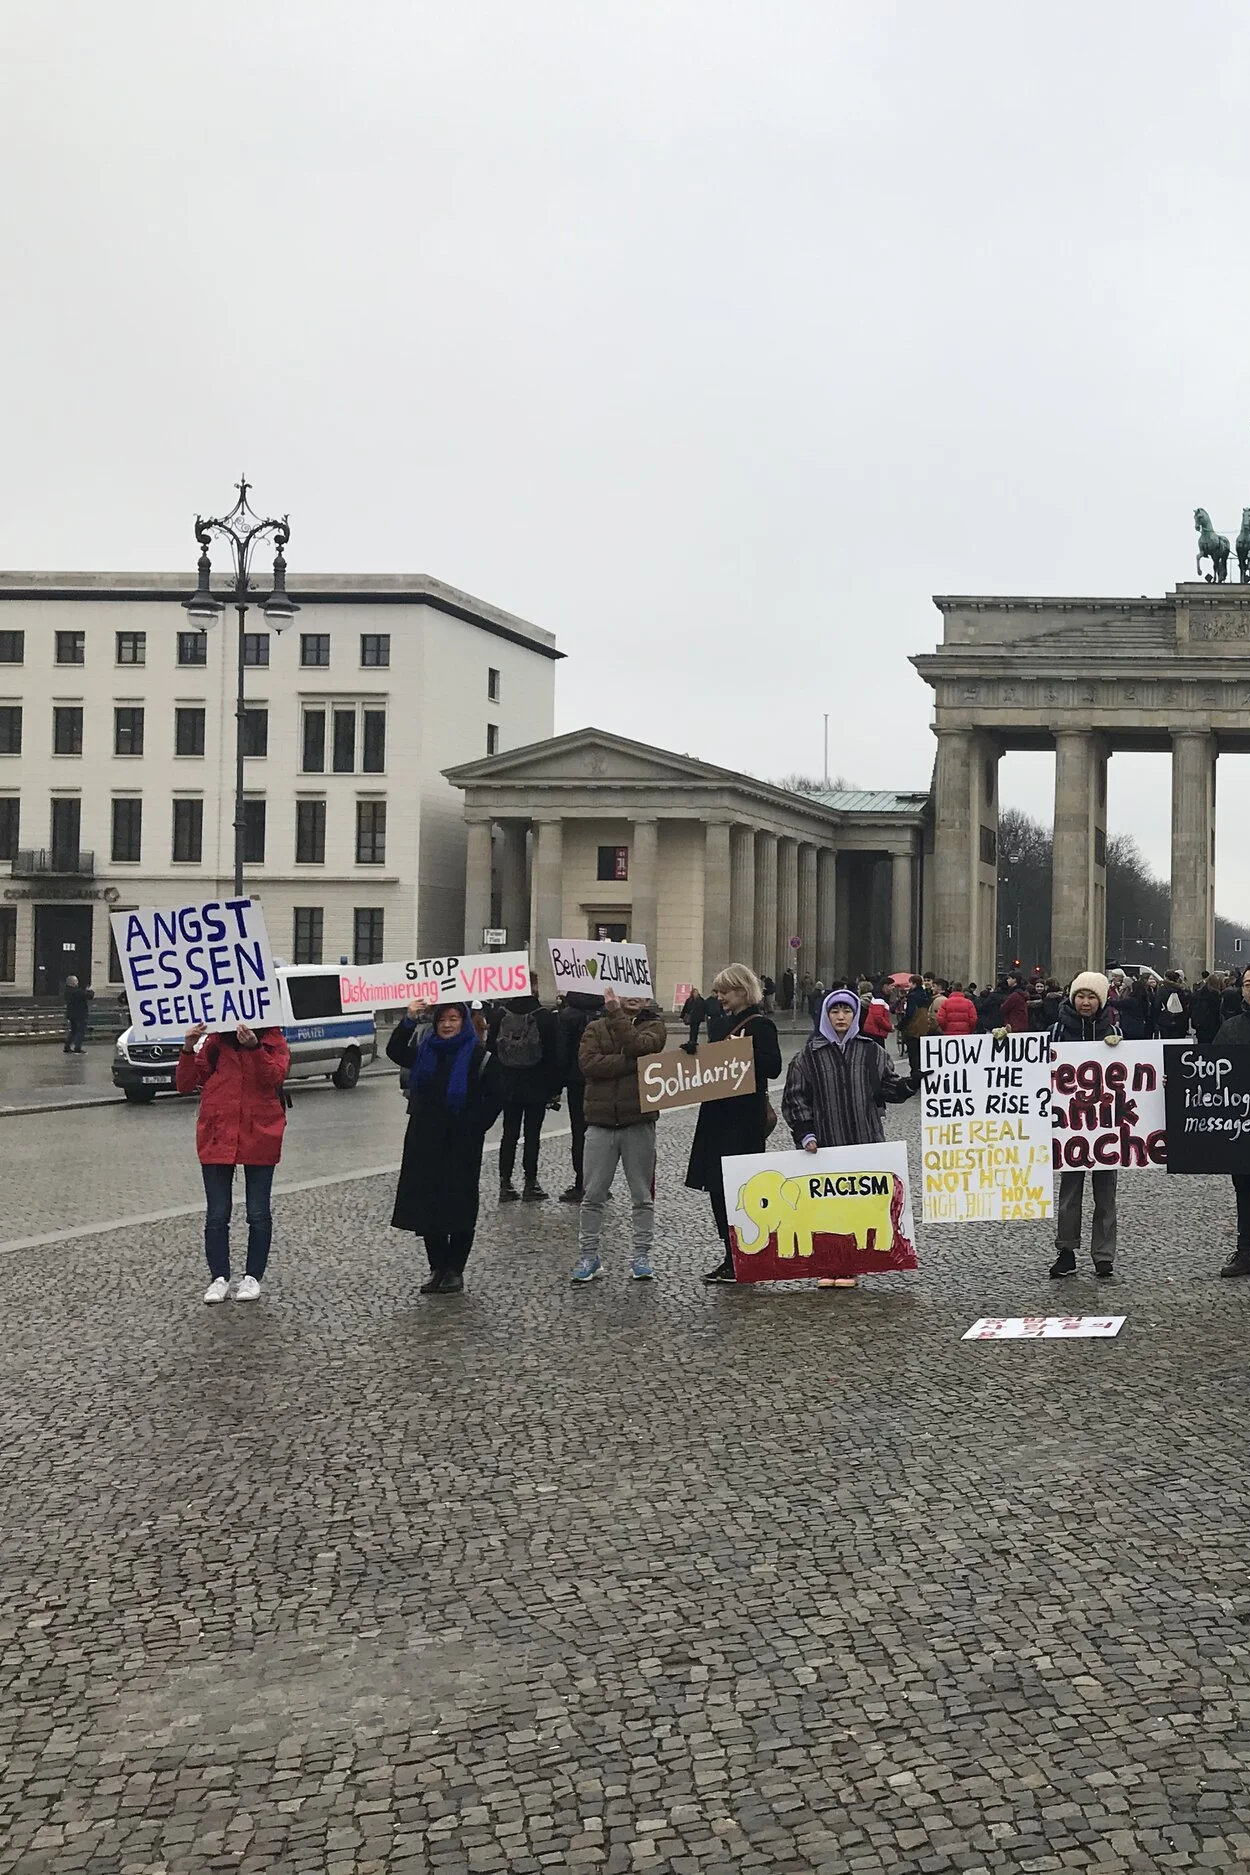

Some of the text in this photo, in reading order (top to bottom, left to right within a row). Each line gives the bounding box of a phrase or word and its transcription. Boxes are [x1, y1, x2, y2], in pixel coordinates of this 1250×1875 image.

[126, 900, 252, 952] ANGST
[129, 942, 265, 991] ESSEN
[406, 957, 459, 980] STOP
[460, 965, 527, 994] VIRUS
[552, 948, 651, 986] Berlin ZUHAUSE
[139, 987, 270, 1026] SEELE AUF
[926, 1035, 1051, 1068] HOW MUCH
[644, 1056, 751, 1103] Solidarity
[984, 1066, 1023, 1088] THE
[1051, 1050, 1157, 1103] egen
[1180, 1050, 1233, 1090] Stop
[926, 1097, 975, 1117] SEAS
[1052, 1088, 1140, 1131] anik
[924, 1119, 1030, 1145] THE REAL
[809, 1176, 889, 1198] RACISM
[926, 1165, 1032, 1193] NOT HOW
[966, 1192, 996, 1218] BUT
[1001, 1186, 1043, 1202] HOW
[1001, 1200, 1052, 1220] FAST
